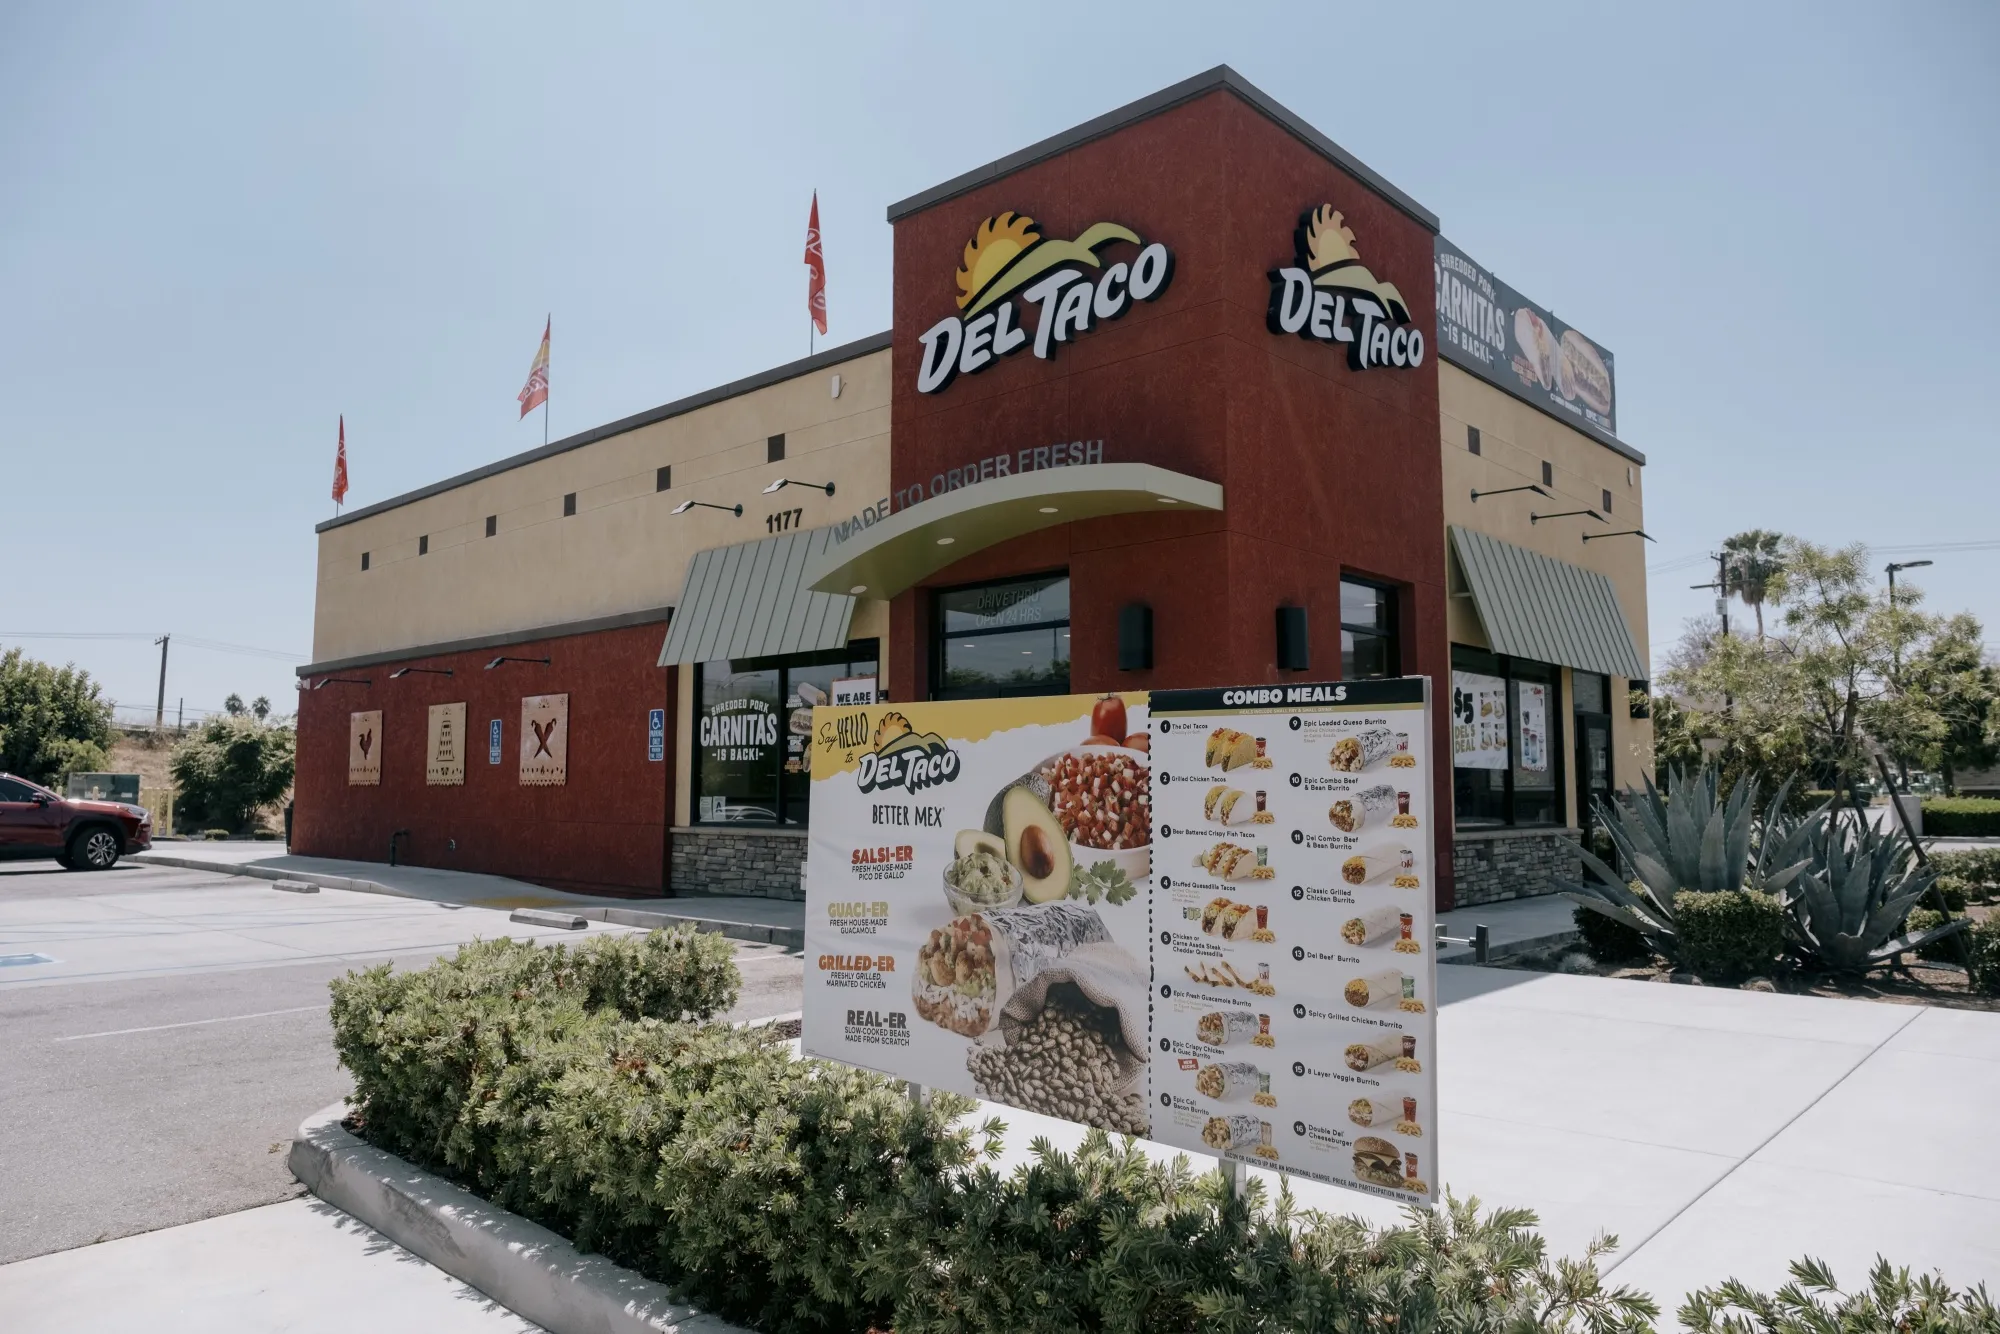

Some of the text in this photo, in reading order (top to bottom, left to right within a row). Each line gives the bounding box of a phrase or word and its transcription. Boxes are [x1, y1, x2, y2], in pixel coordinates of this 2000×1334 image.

[1440, 254, 1476, 282] SHREDDED
[917, 243, 1168, 395] DEL TACO
[1278, 267, 1424, 369] DEL TACO
[834, 440, 1104, 545] MADE TO ORDER FRESH
[766, 508, 803, 534] 1177
[976, 592, 1008, 609] DRIVE
[976, 607, 1042, 627] OPEN 24 HRS
[837, 692, 870, 703] WE ARE
[1222, 686, 1347, 706] COMBO MEALS
[711, 699, 747, 716] SHREDDED
[750, 700, 770, 714] PORK
[1454, 687, 1474, 724] $5
[700, 713, 778, 747] CARNITAS
[1304, 720, 1316, 728] Epic
[1454, 724, 1476, 740] DEL'S
[818, 722, 838, 753] Say
[837, 712, 868, 749] HELLO
[1454, 738, 1476, 754] DEAL
[844, 750, 853, 764] to
[858, 749, 956, 790] DEL TACO
[872, 804, 910, 826] BETTER
[1208, 830, 1226, 838] Crispy
[852, 846, 913, 864] SALSI-ER
[852, 863, 912, 873] FRESH HOUSE-MADE
[858, 871, 904, 880] PICO DE GALLO
[1192, 882, 1220, 890] Quesadilla
[1306, 894, 1355, 904] Chicken Burrito
[828, 901, 888, 918] GUACI-ER
[840, 926, 876, 934] GUACAMOLE
[849, 918, 888, 926] HOUSE-MADE
[1173, 946, 1194, 954] Cheddar
[818, 954, 896, 972] GRILLED-ER
[1337, 956, 1360, 964] Burrito
[826, 980, 886, 988] MARINATED CHICKEN
[830, 972, 854, 980] FRESHLY
[1174, 990, 1252, 1008] Epic Fresh Guacamole Burrito
[847, 1010, 906, 1029] REAL-ER
[1308, 1010, 1402, 1030] Spicy Grilled Chicken Burrito
[844, 1026, 910, 1038] SLOW-COOKED BEANS
[845, 1034, 910, 1046] MADE FROM SCRATCH
[1172, 1040, 1184, 1049] Epic
[1186, 1042, 1202, 1052] Crispy
[1204, 1045, 1224, 1055] Chicken
[1178, 1048, 1191, 1056] Guac
[1192, 1051, 1210, 1060] Burrito
[1314, 1070, 1330, 1079] Layer
[1332, 1072, 1354, 1083] Veggie
[1356, 1076, 1380, 1086] Burrito
[1174, 1096, 1184, 1104] Epic
[1186, 1098, 1196, 1106] Cali
[1174, 1102, 1210, 1116] Bacon Burrito
[1308, 1124, 1330, 1134] Double
[1332, 1129, 1343, 1137] Del
[1308, 1132, 1352, 1146] Cheeseburger
[1332, 1178, 1347, 1186] PRICE
[1348, 1180, 1358, 1188] AND
[1358, 1184, 1394, 1198] PARTICIPATION
[1396, 1192, 1406, 1200] MAY
